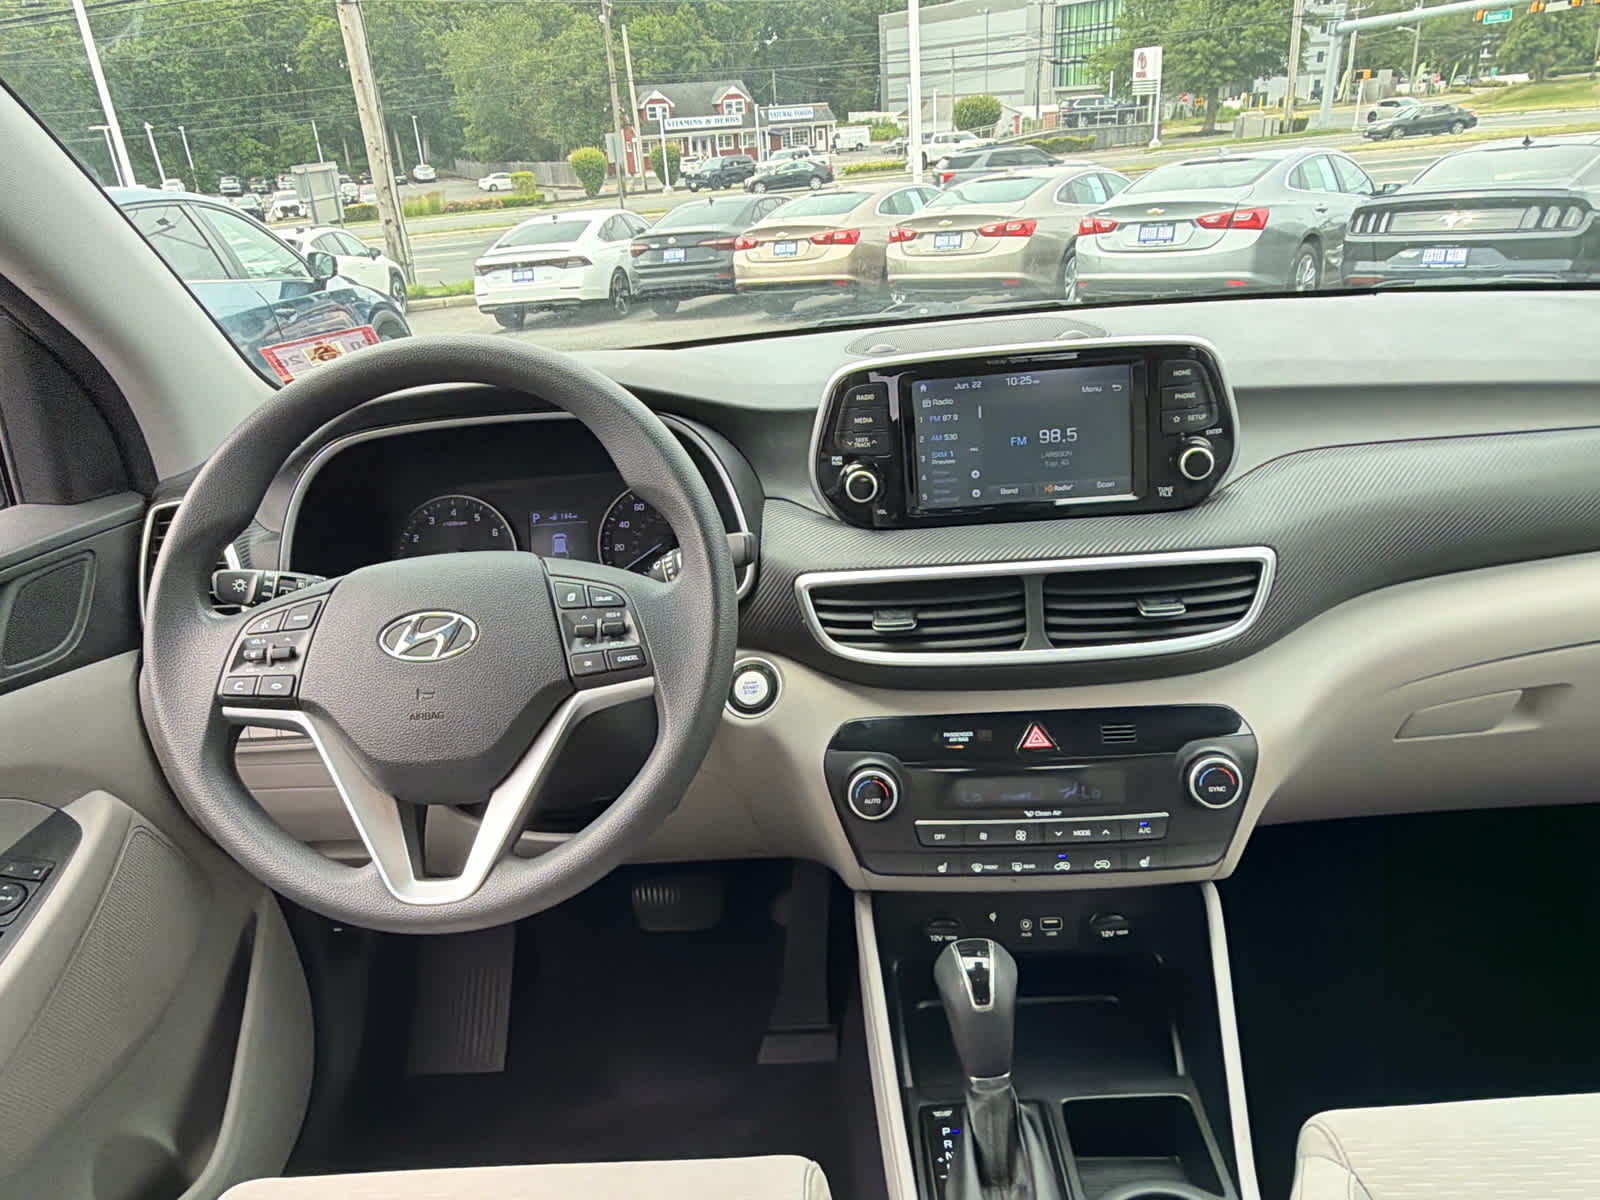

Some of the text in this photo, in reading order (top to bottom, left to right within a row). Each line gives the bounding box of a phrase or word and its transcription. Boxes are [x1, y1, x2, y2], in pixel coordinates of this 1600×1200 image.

[665, 119, 702, 128] VITAMINS
[1172, 369, 1192, 377] HOME
[971, 380, 982, 388] 22
[1006, 376, 1033, 386] 10:25
[1081, 385, 1103, 393] Menu
[1174, 392, 1197, 400] PHONE
[932, 398, 954, 406] Radio
[1187, 413, 1208, 421] SETUP
[1039, 427, 1078, 444] 98.5
[1010, 436, 1028, 446] FM
[428, 516, 436, 525] 3
[473, 513, 481, 522] 5
[532, 513, 541, 523] P
[614, 543, 625, 551] 20
[617, 654, 639, 663] CANCEL
[408, 711, 445, 721] AIRBAG
[1138, 826, 1152, 834] A/C
[1100, 930, 1115, 938] 12V
[942, 1127, 951, 1137] P
[943, 1139, 953, 1149] R
